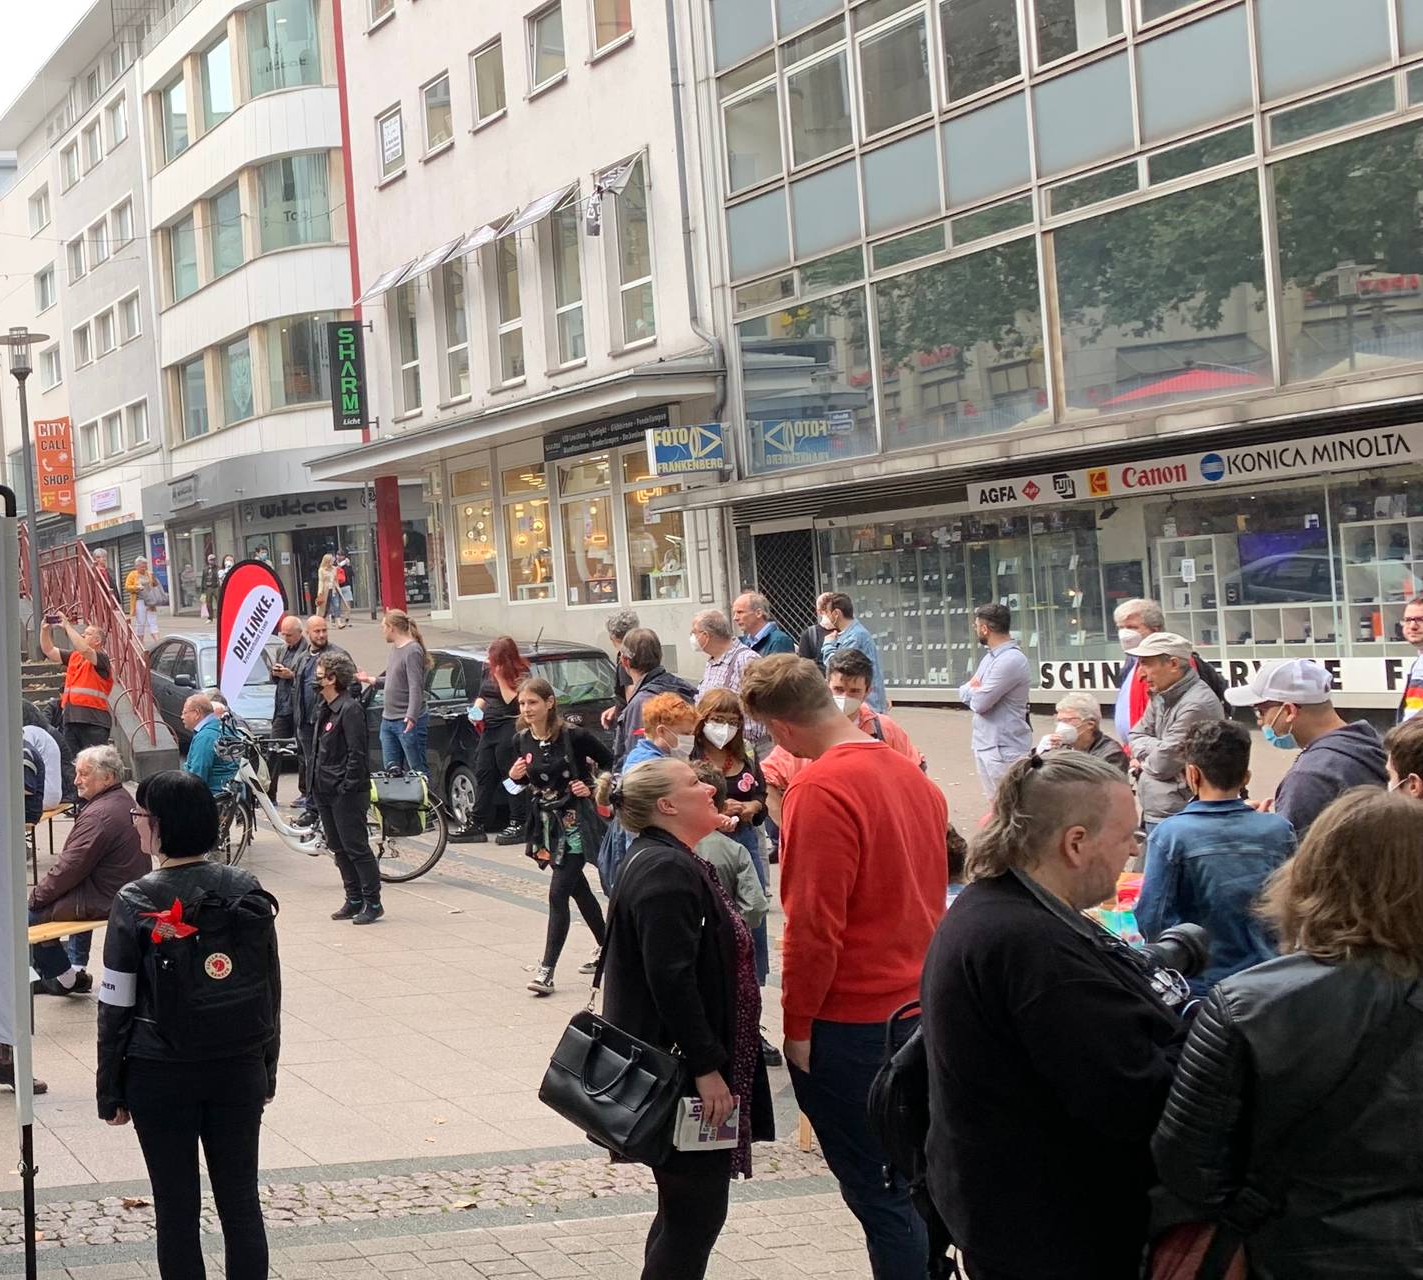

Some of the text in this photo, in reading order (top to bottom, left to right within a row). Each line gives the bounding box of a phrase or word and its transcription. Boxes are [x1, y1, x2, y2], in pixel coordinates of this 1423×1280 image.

[338, 327, 359, 410] SHARM
[38, 423, 66, 437] CITY
[654, 428, 689, 447] FOTO
[41, 439, 67, 450] CALL
[1227, 433, 1411, 475] KONICA MINOLTA
[657, 458, 723, 473] FRANKENBERG
[43, 474, 69, 486] SHOP
[1121, 464, 1187, 488] Canon
[979, 485, 1017, 505] AGFA
[233, 632, 251, 661] DIE
